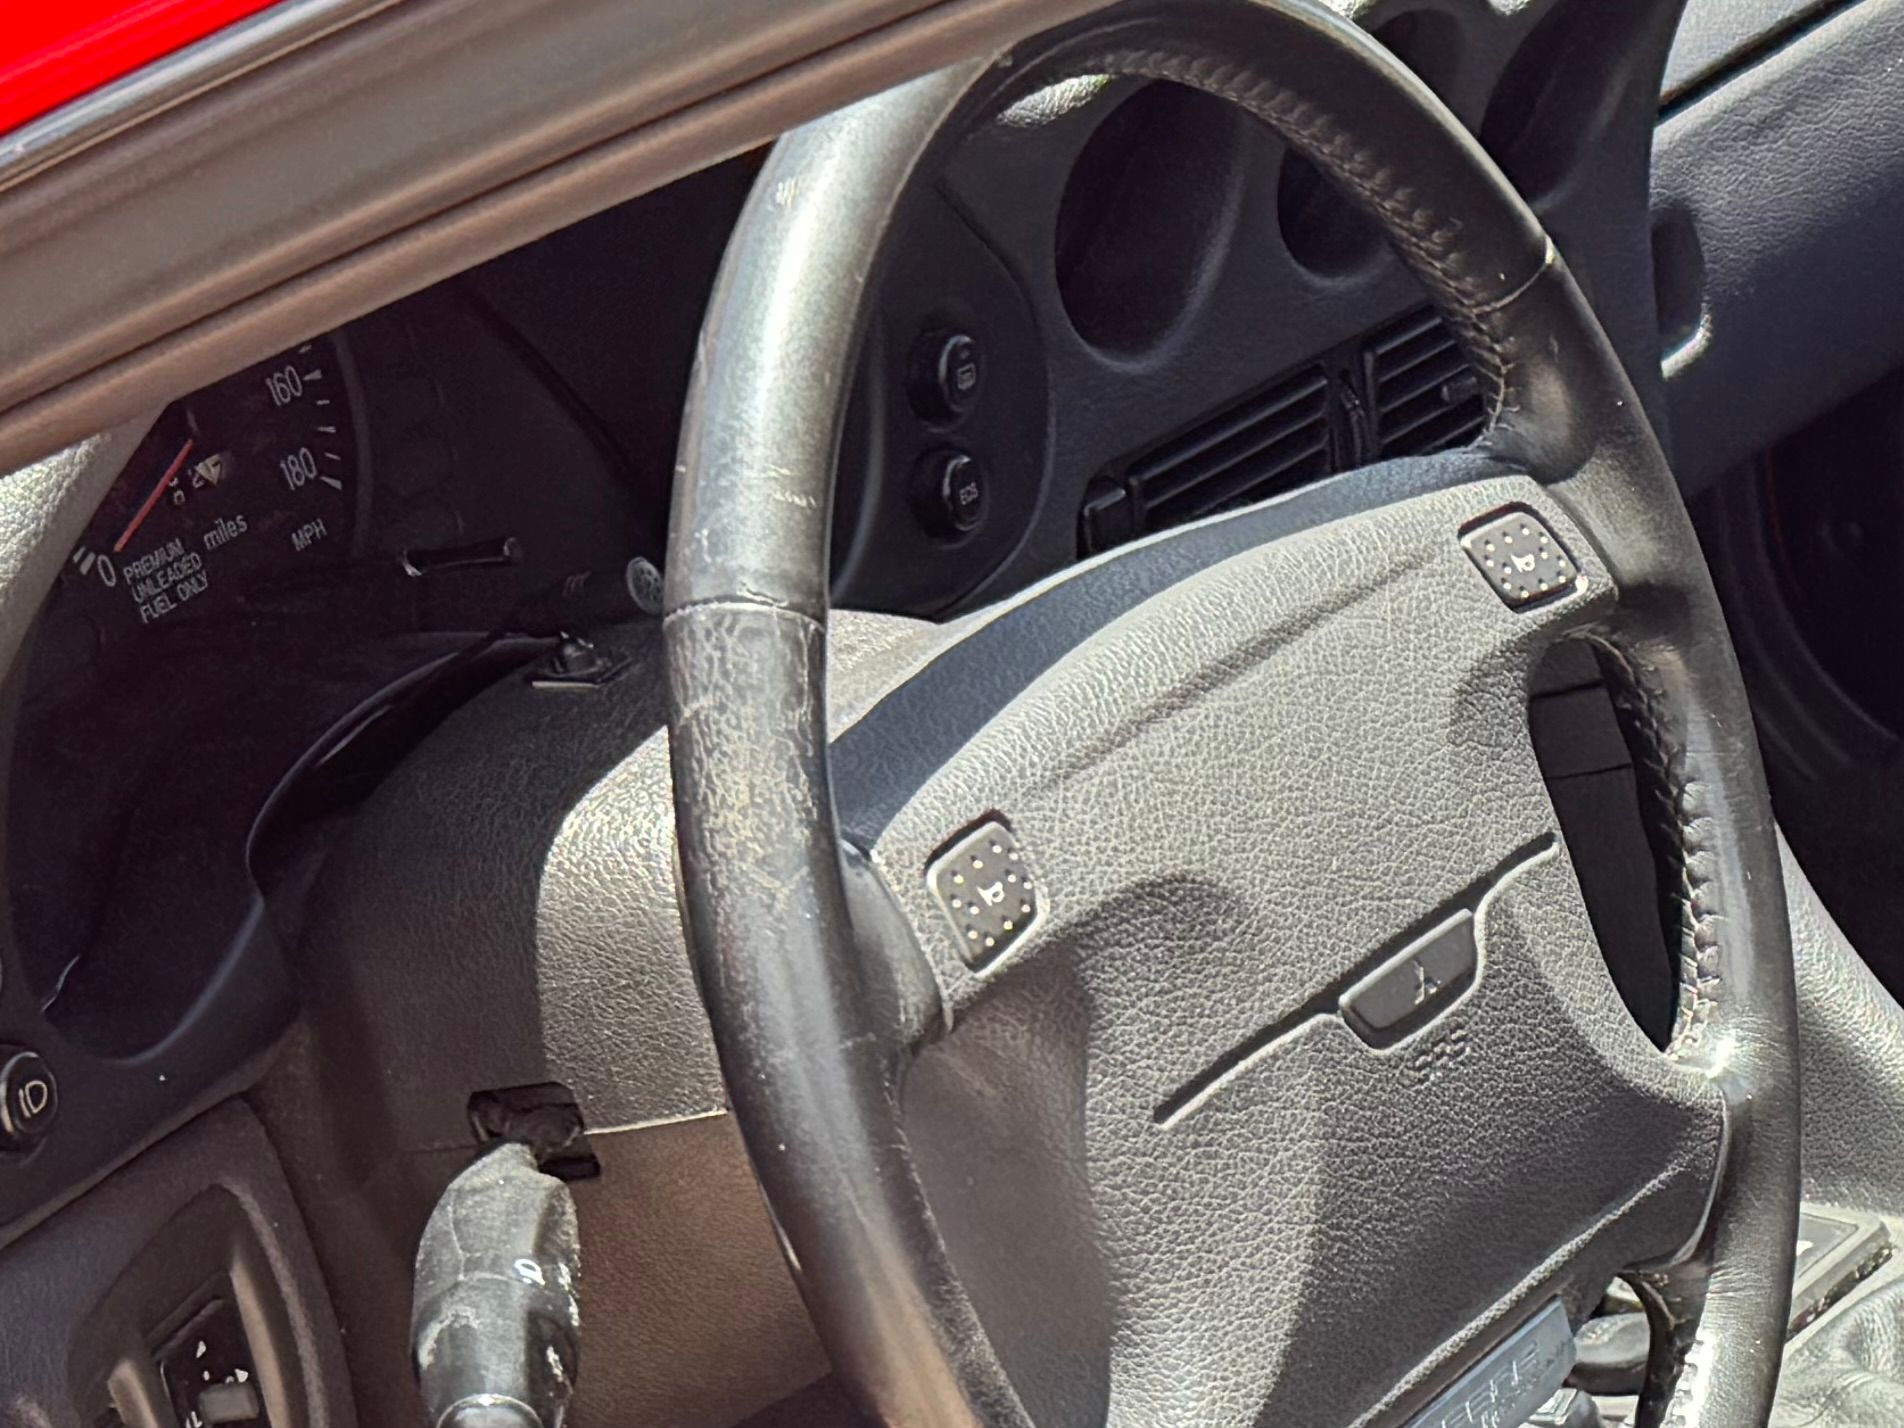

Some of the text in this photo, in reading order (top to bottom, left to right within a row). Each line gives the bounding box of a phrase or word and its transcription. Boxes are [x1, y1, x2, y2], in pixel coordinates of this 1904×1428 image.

[265, 365, 303, 407] 160
[280, 447, 318, 491] 180
[203, 514, 248, 550] miles
[291, 518, 328, 552] MPH
[97, 554, 116, 587] 0
[122, 538, 185, 585] PREMIUM
[131, 552, 202, 602] UNLEADED
[140, 570, 209, 624] FUEL ONLY
